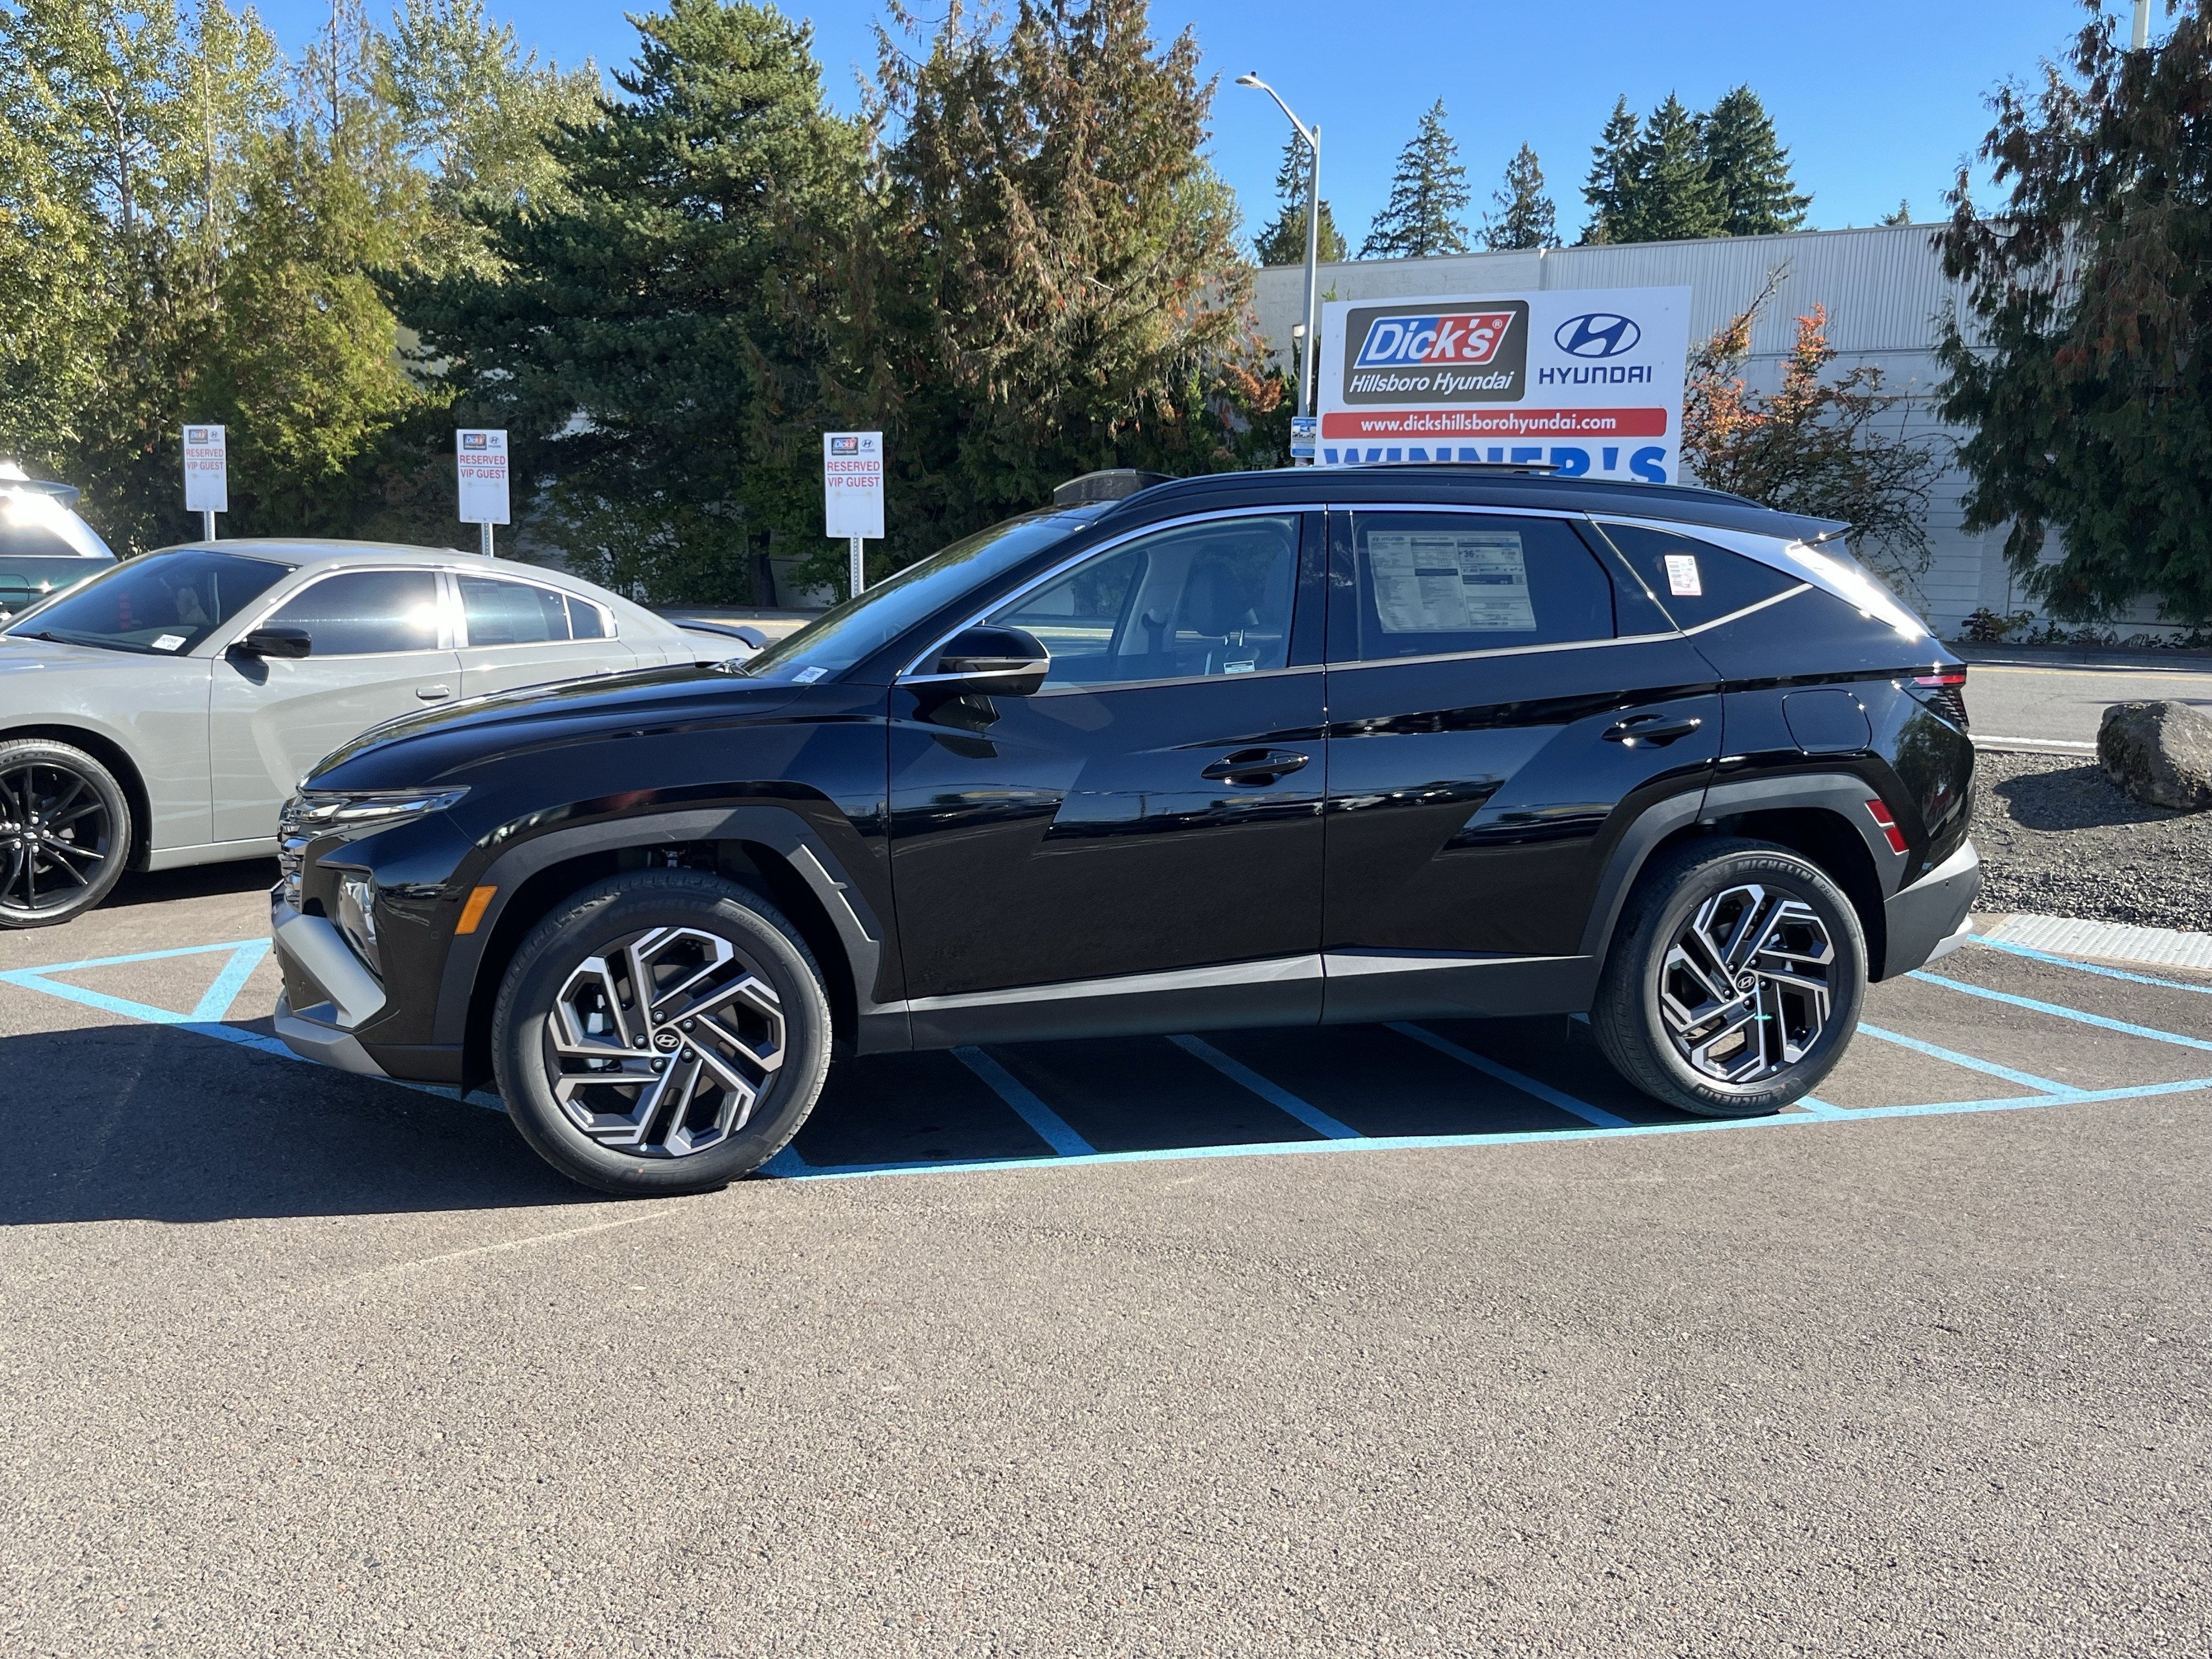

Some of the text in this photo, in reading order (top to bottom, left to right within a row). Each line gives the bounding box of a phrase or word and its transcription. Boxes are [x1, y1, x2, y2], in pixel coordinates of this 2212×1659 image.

[1365, 319, 1494, 360] Dick's
[1538, 366, 1652, 385] HYUNDAI
[1349, 371, 1515, 396] Hillsboro Hyundai
[1361, 413, 1616, 434] www.dickshillsborohyundai.com
[186, 448, 224, 458] RESERVED
[187, 461, 224, 470] VIP GUEST
[459, 455, 505, 465] RESERVED
[827, 461, 880, 472] RESERVED
[460, 469, 506, 479] VIP GUEST
[828, 477, 881, 487] VIP GUEST
[1737, 860, 1813, 881] MICHELIN
